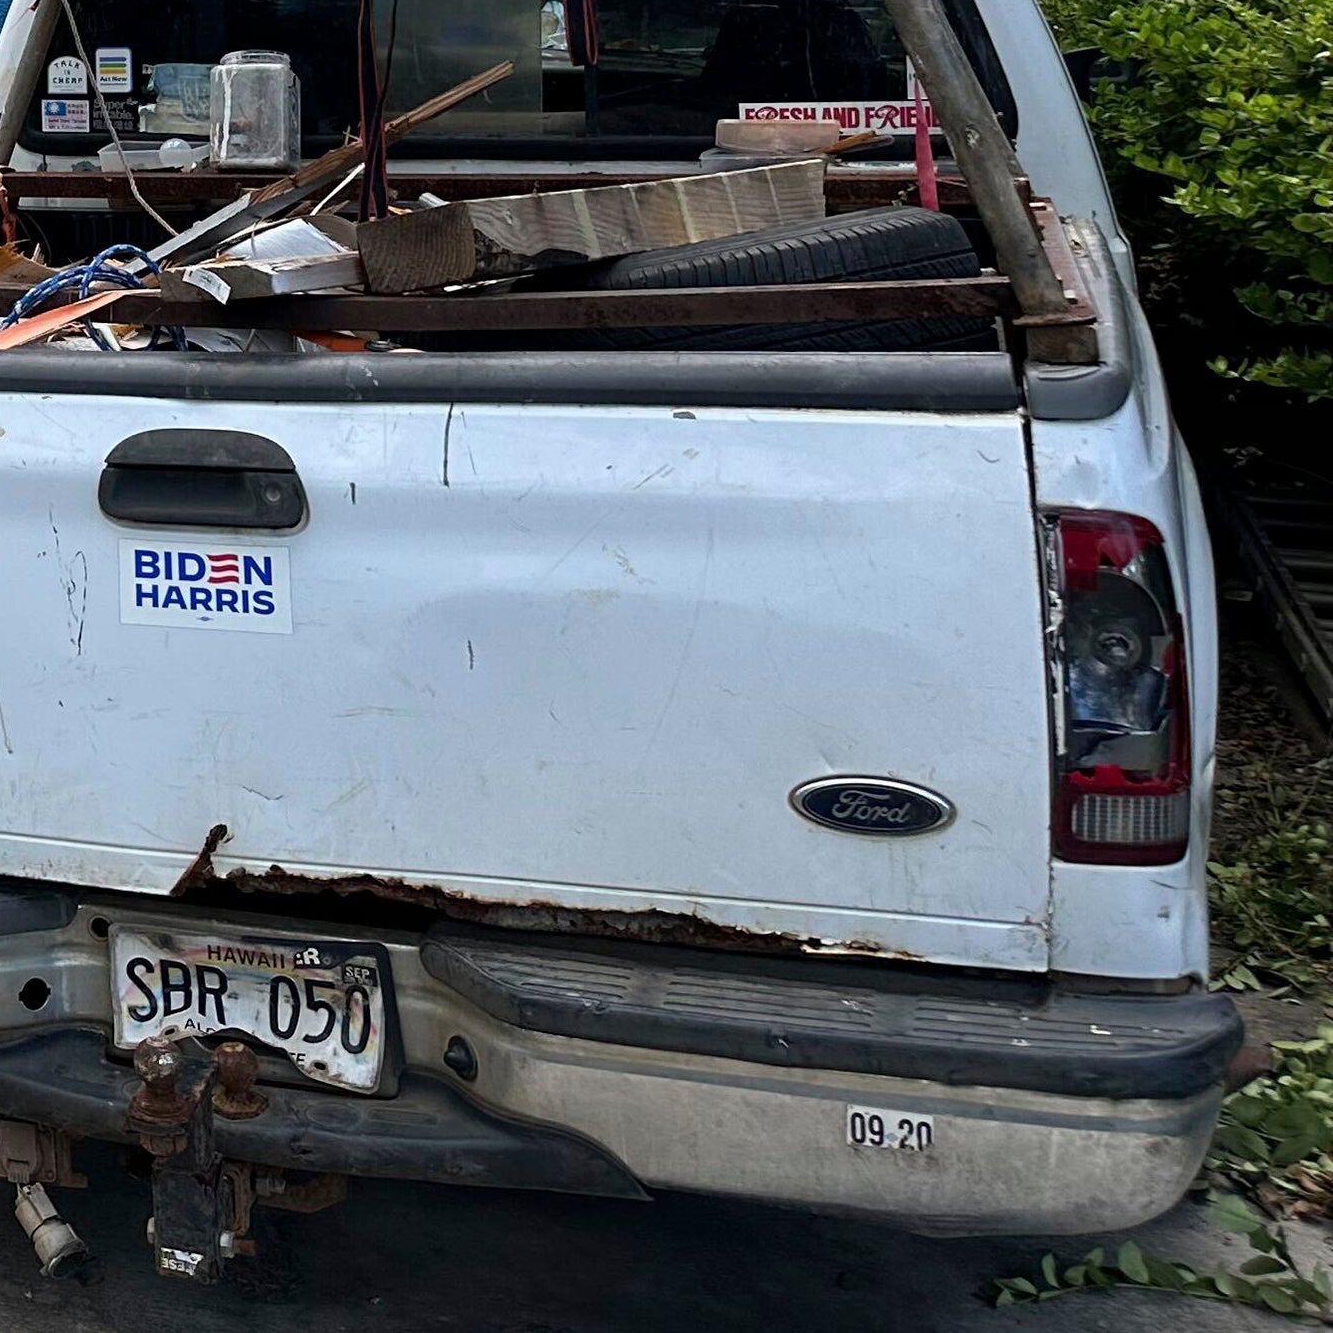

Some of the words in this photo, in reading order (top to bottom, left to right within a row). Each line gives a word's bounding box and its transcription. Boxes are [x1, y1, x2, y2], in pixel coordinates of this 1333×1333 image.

[134, 549, 273, 586] BIDEN
[135, 583, 275, 615] HARRIS
[832, 789, 912, 823] Ford
[207, 944, 286, 969] HAWAII
[126, 956, 229, 1026] SBR
[268, 975, 371, 1055] 050
